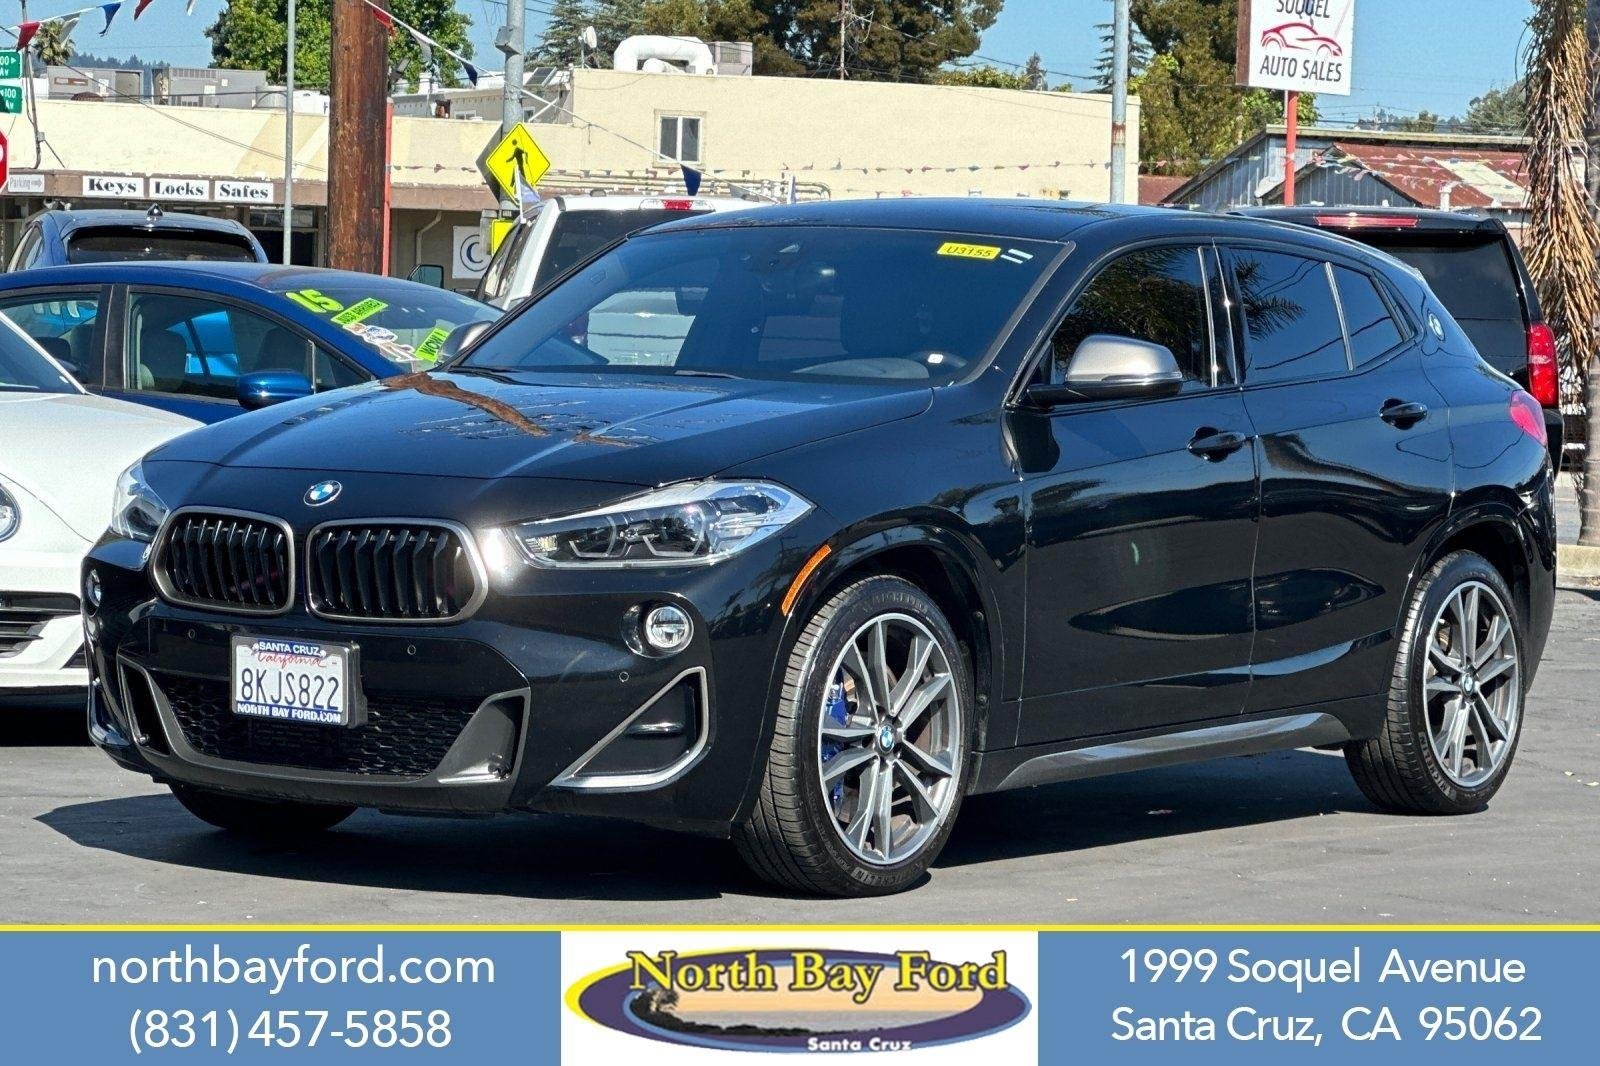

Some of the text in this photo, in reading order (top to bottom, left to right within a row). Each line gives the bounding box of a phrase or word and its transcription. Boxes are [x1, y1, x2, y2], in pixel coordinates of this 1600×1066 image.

[1260, 55, 1343, 82] AUTO SALES
[88, 178, 137, 195] Keys
[154, 181, 204, 197] Locks
[219, 183, 269, 199] Safes
[945, 245, 994, 257] U3155
[258, 641, 321, 656] SANTA CRUZ
[257, 651, 327, 669] California
[241, 667, 340, 710] 8KJS822
[237, 702, 341, 724] NORTH BAY FORD.COM
